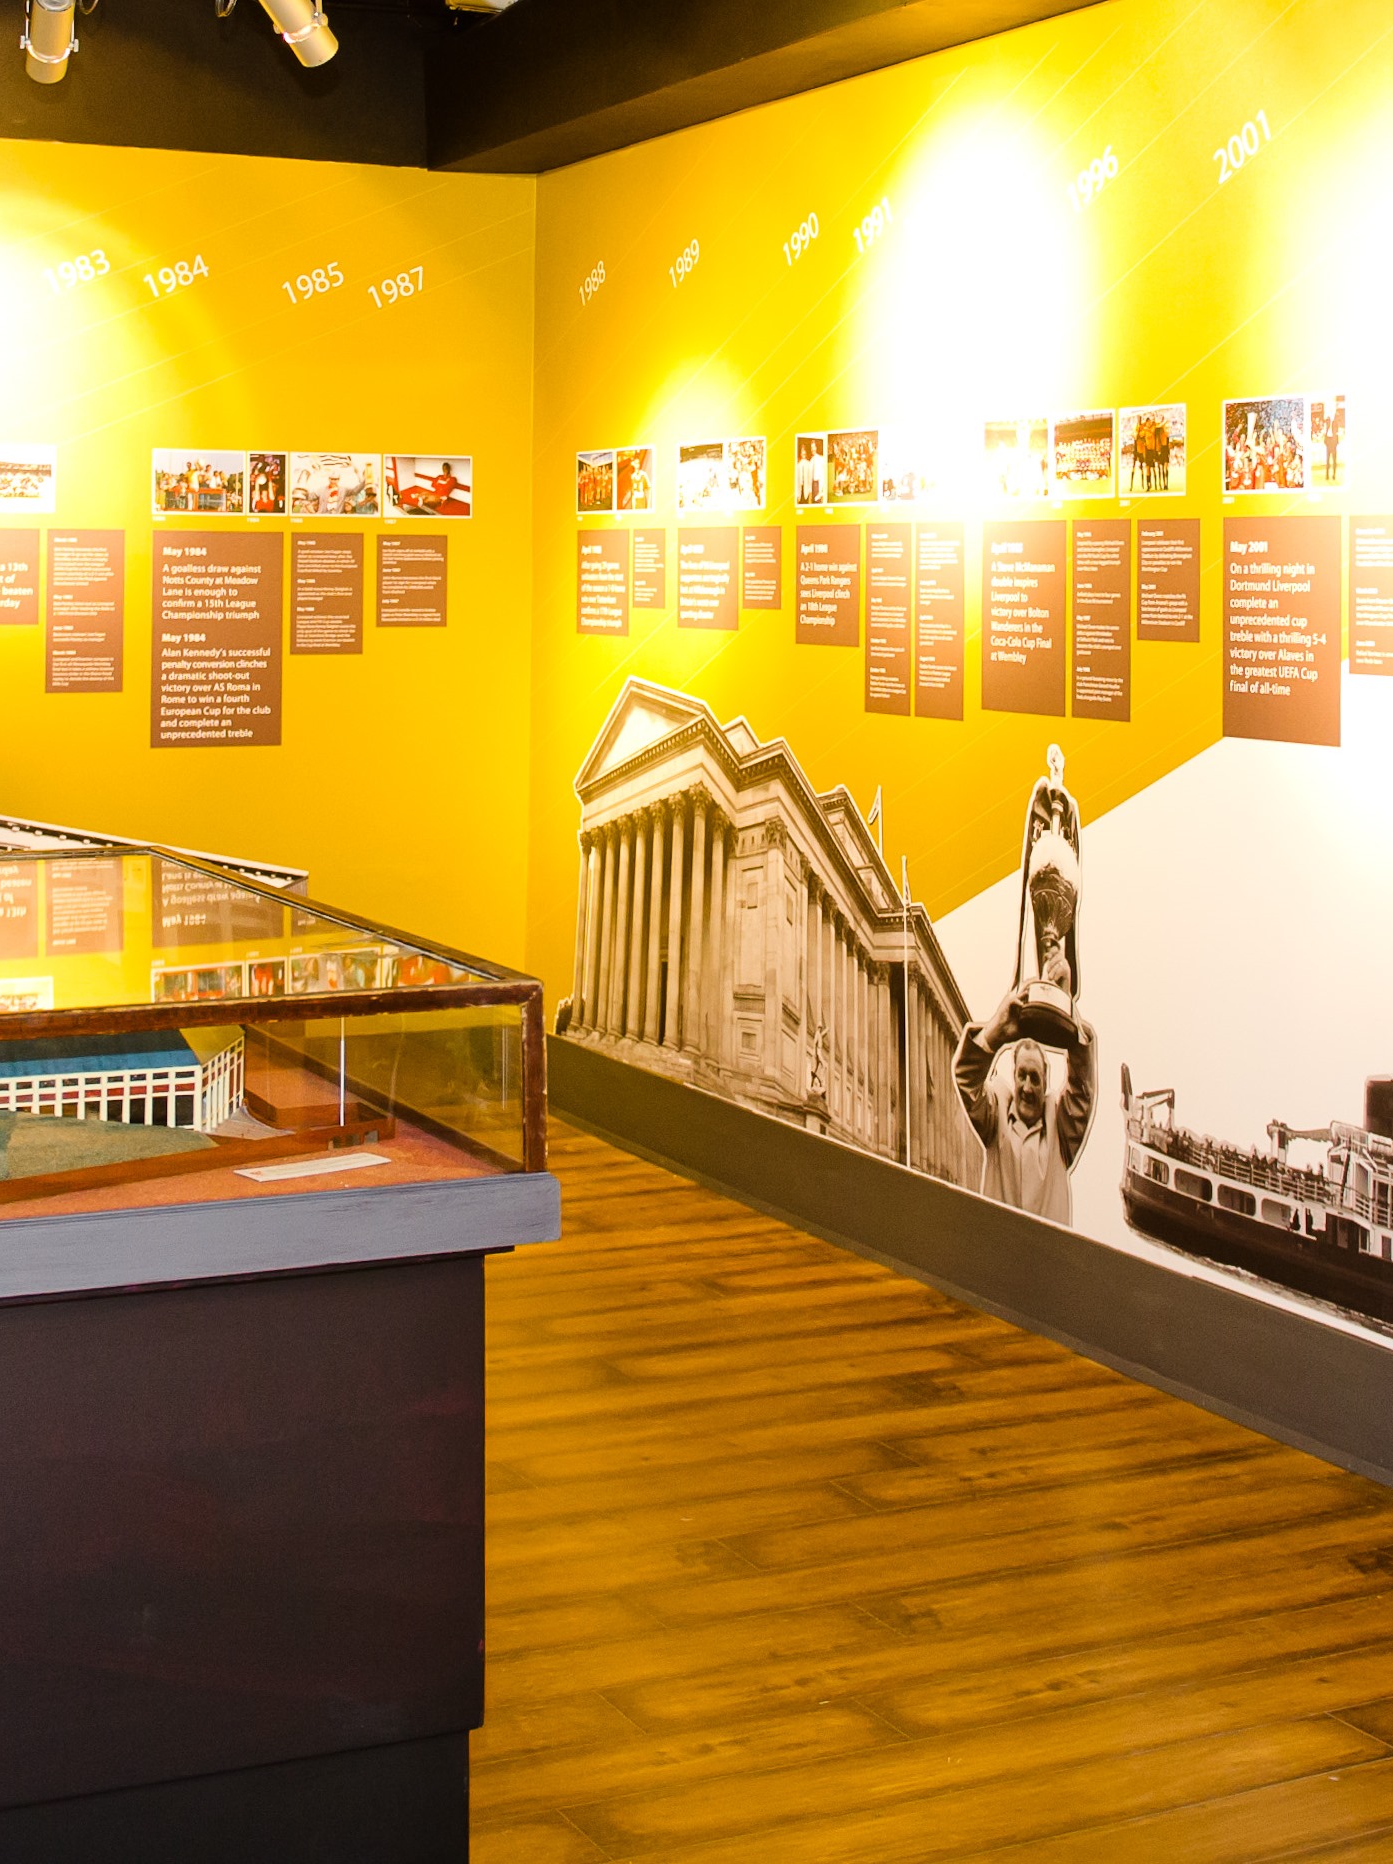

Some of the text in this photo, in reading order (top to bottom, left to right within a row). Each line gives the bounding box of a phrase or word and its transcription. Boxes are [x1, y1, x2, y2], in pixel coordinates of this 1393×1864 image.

[1212, 109, 1271, 184] 2001
[1066, 147, 1118, 213] 1996
[782, 212, 819, 266] 1990
[852, 197, 893, 254] 1991
[42, 249, 110, 295] 1983
[143, 254, 209, 298] 1984
[282, 261, 345, 304] 1985
[578, 260, 606, 306] 1988
[669, 238, 700, 289] 1989
[367, 265, 425, 309] 1987
[162, 547, 207, 557] May 1984
[162, 564, 261, 575] A goalless draw against
[1230, 541, 1268, 555] May 2001
[1230, 579, 1311, 594] Dortmund Liverpool
